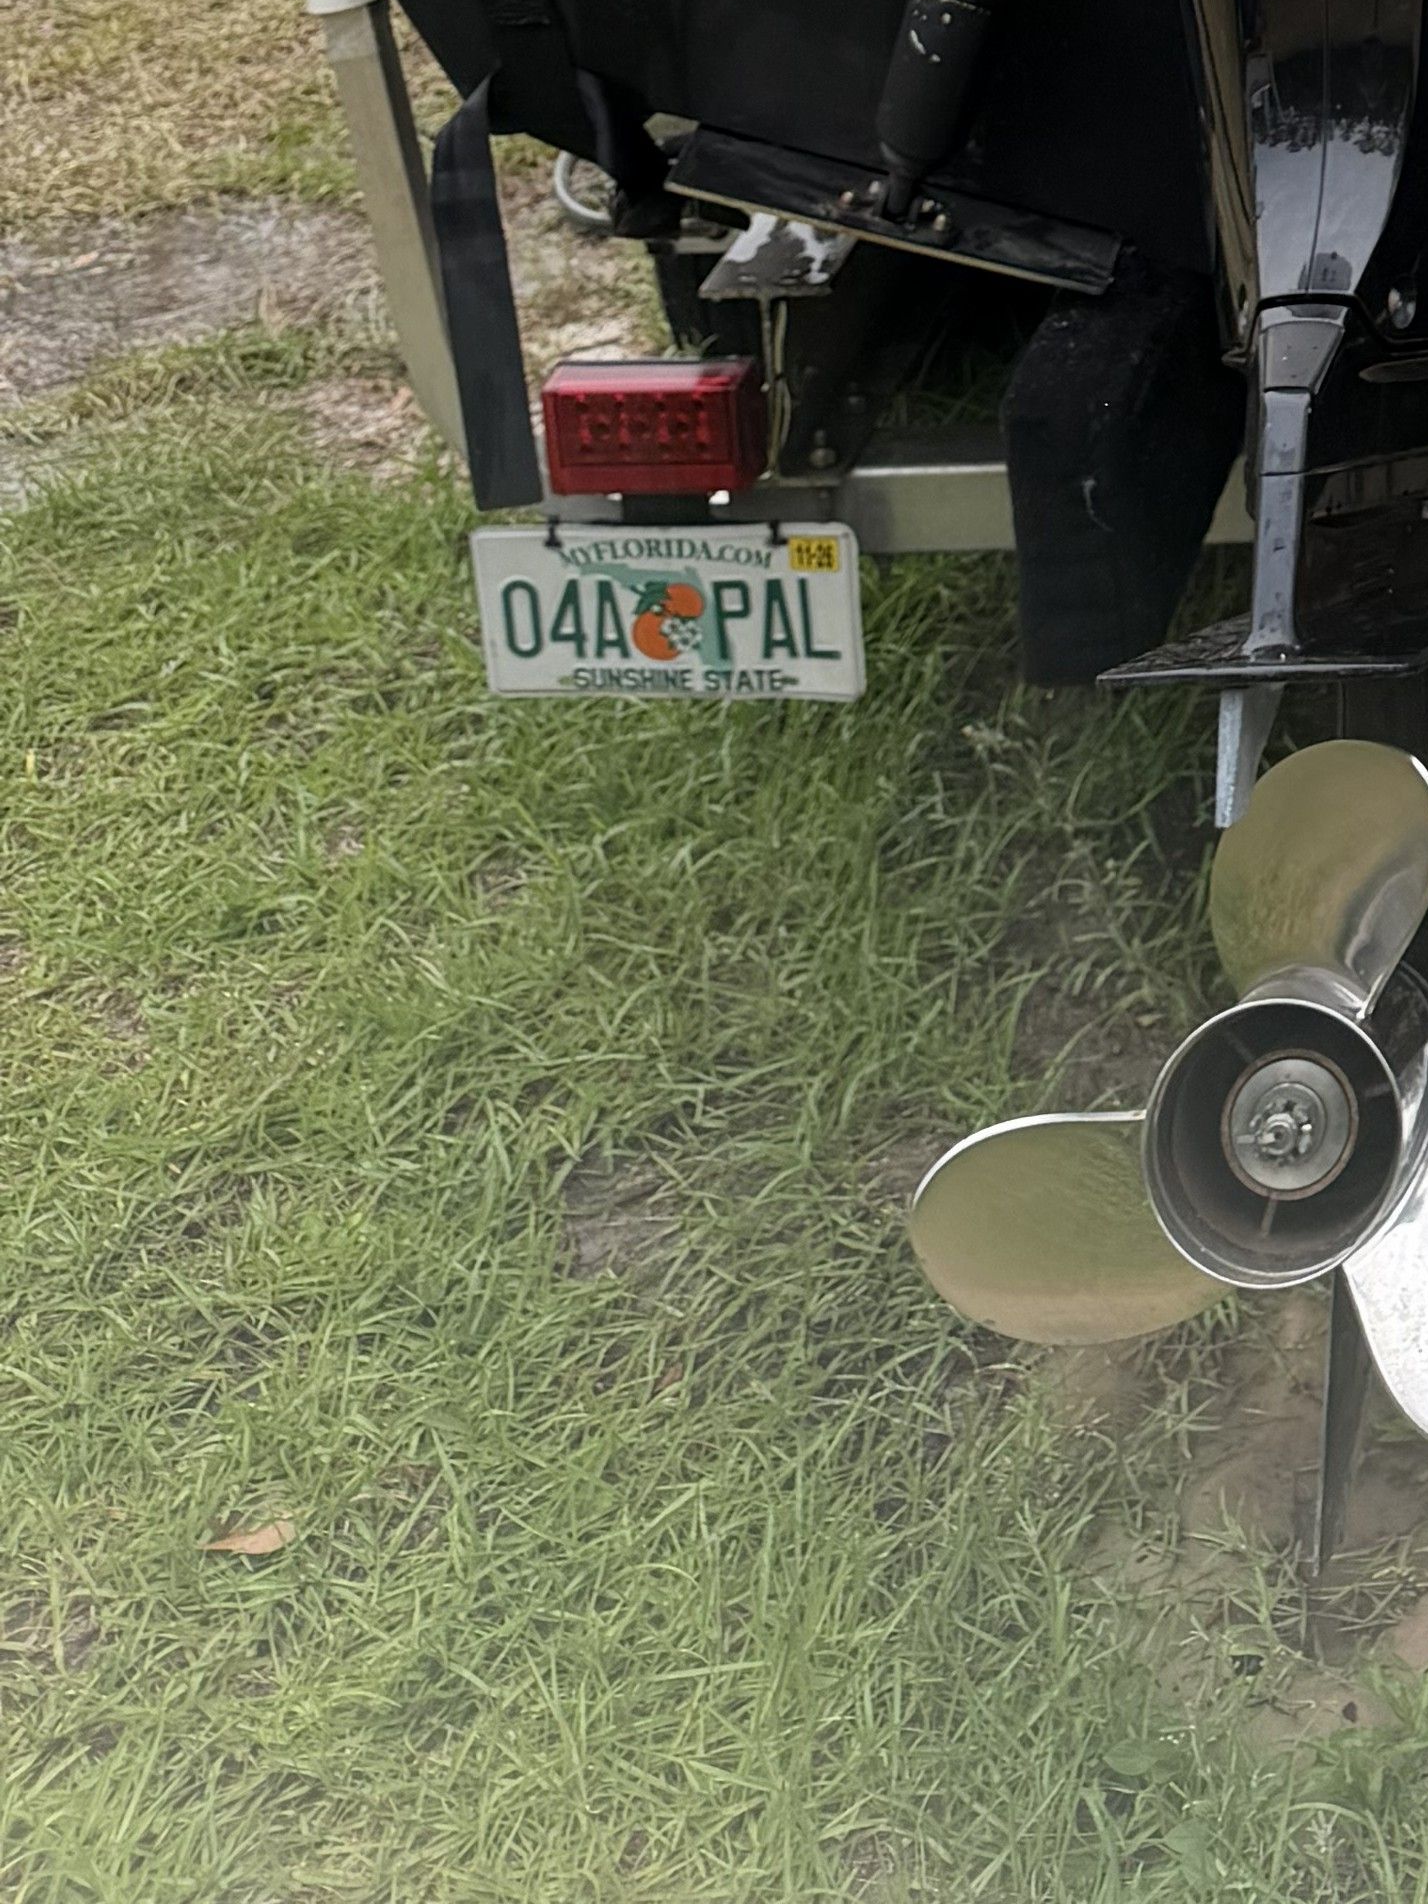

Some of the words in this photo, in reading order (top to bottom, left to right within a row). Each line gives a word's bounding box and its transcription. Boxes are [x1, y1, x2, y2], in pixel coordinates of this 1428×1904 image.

[559, 537, 772, 569] MYFLORIDA.COM
[712, 578, 842, 660] PAL
[573, 667, 692, 691] SUNSHINE
[703, 669, 784, 692] STATE
